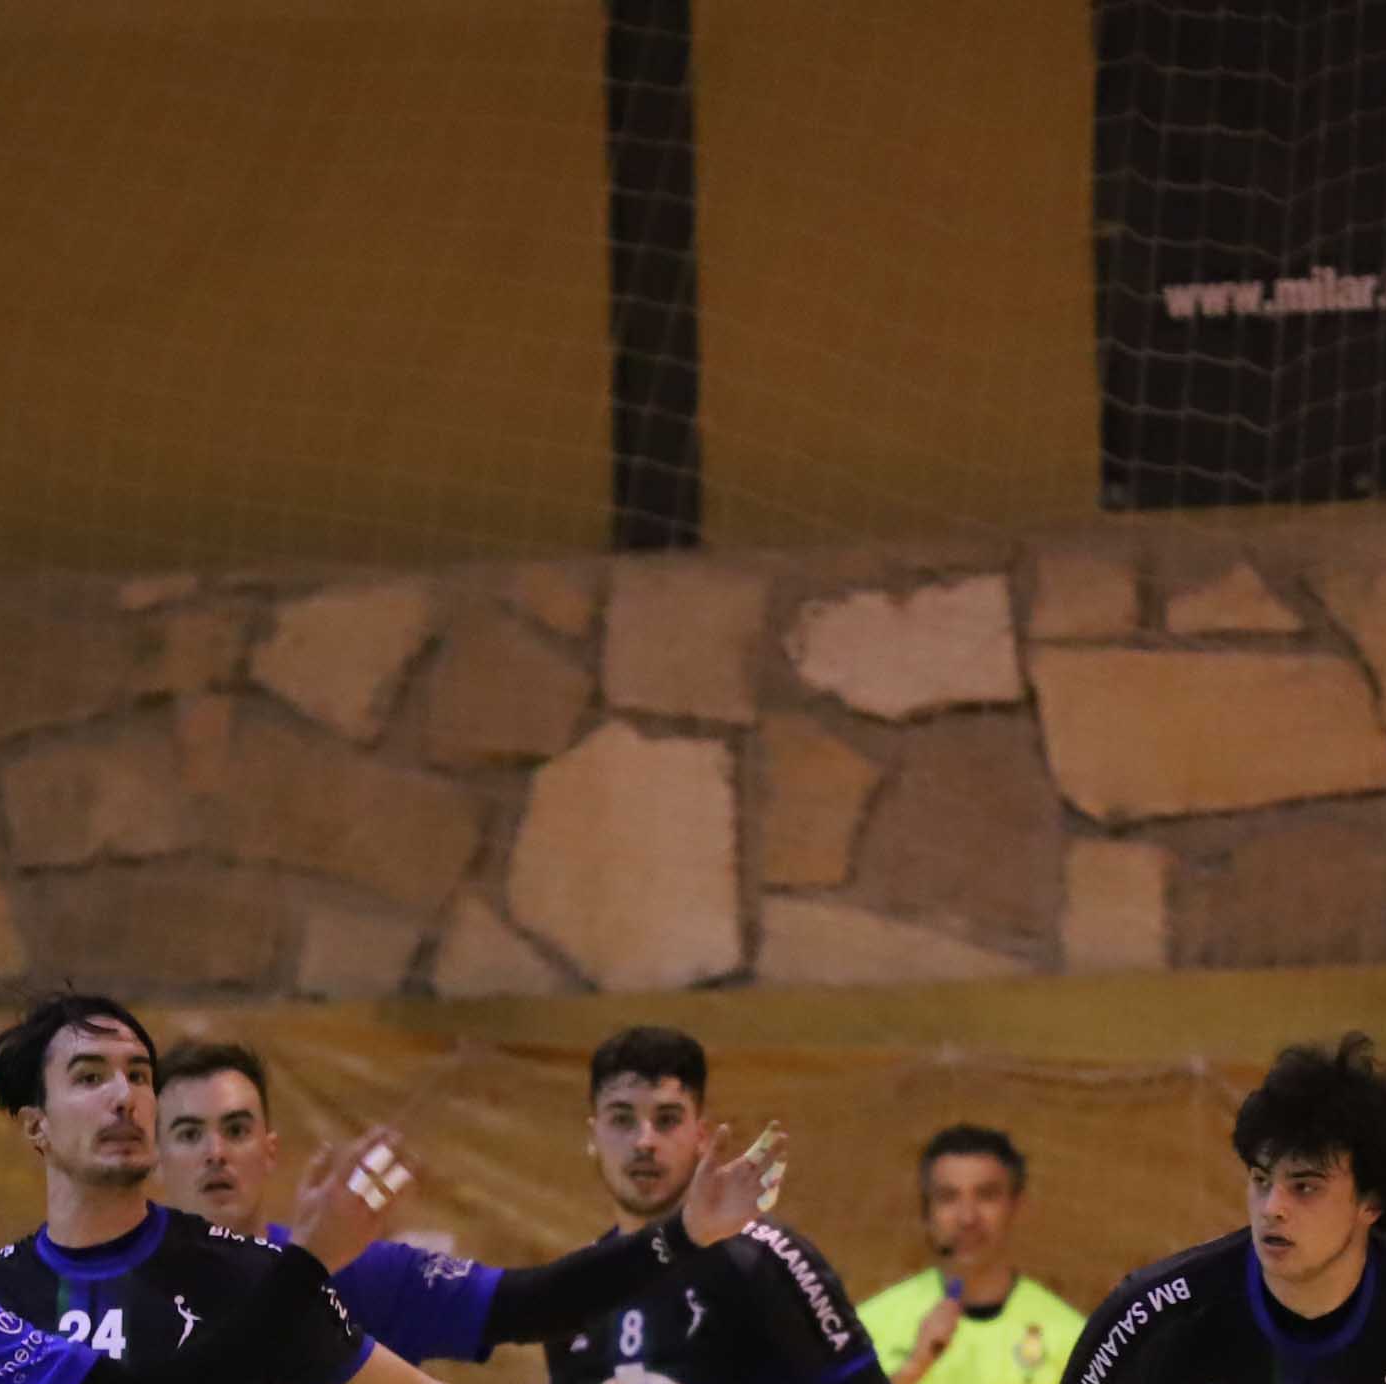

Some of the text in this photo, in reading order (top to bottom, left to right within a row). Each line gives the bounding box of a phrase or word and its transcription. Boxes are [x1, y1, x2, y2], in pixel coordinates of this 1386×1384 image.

[1146, 1276, 1192, 1312] BM
[58, 1308, 127, 1360] 24
[619, 1308, 644, 1357] 8
